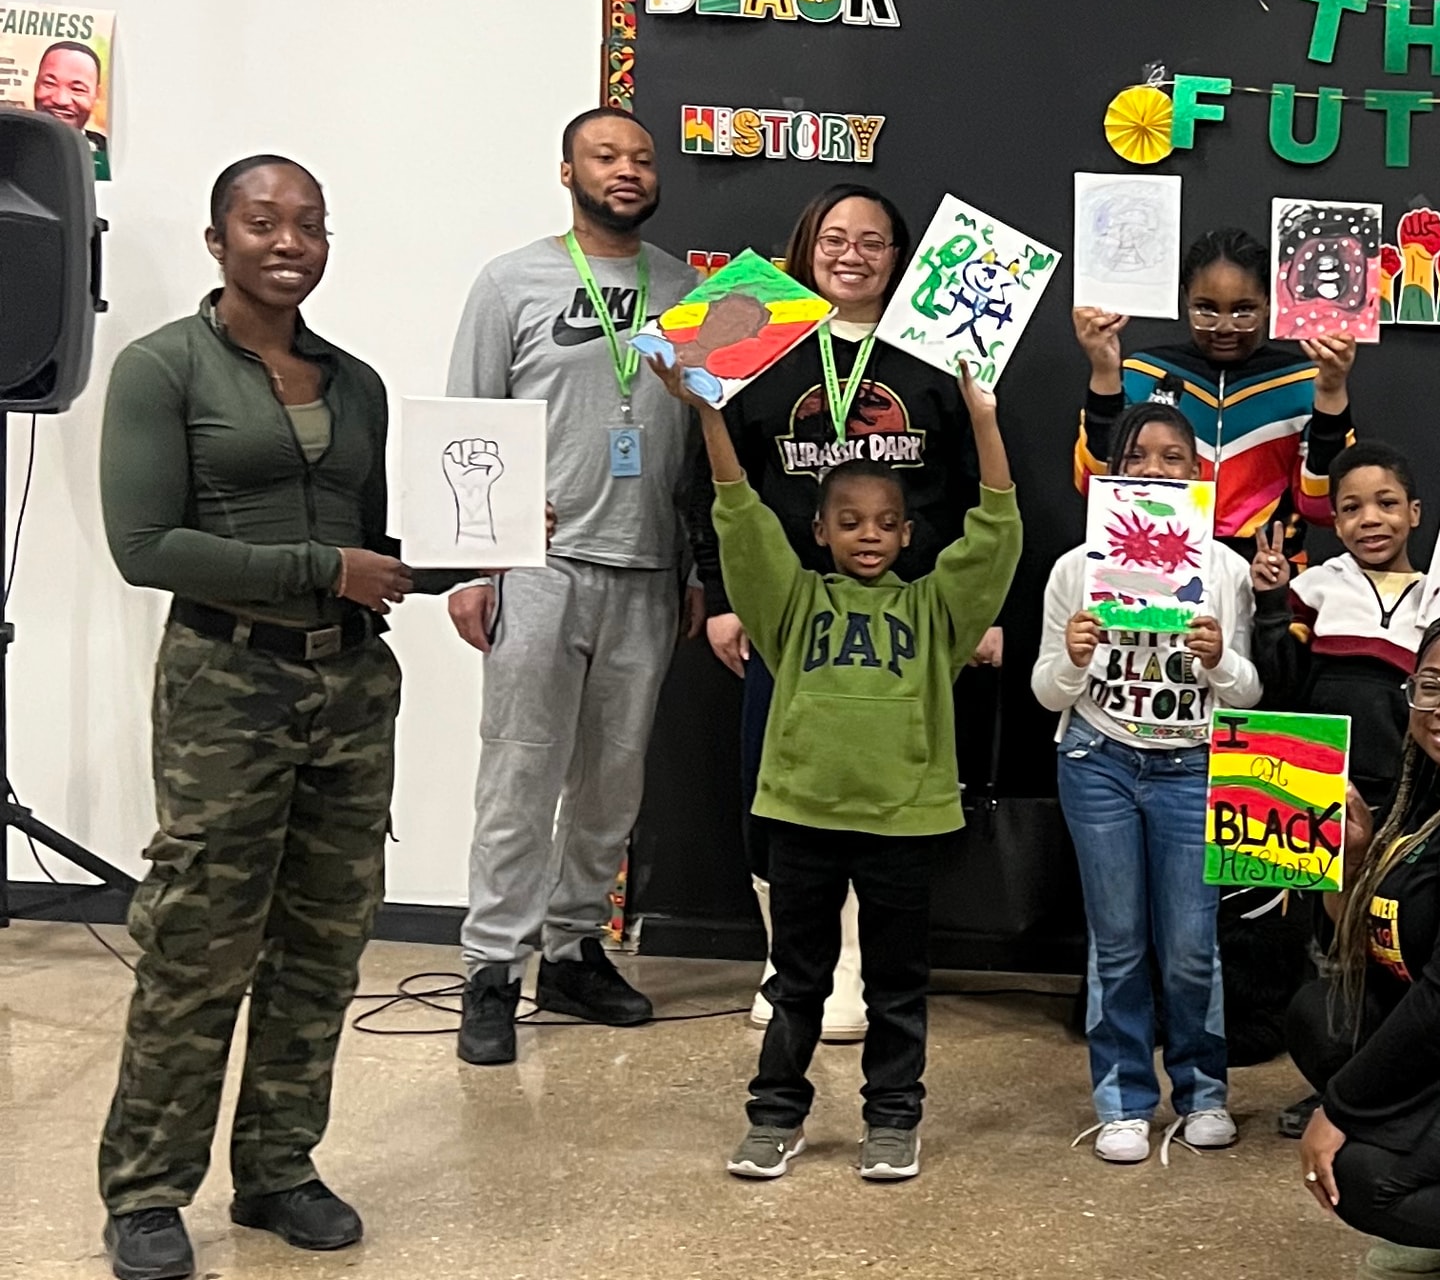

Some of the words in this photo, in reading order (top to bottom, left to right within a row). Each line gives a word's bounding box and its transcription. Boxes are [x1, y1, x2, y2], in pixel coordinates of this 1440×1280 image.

[681, 105, 885, 162] HISTORY
[868, 433, 922, 461] PARK
[803, 610, 915, 678] GAP
[1217, 716, 1249, 749] I
[1212, 801, 1342, 857] BLACK
